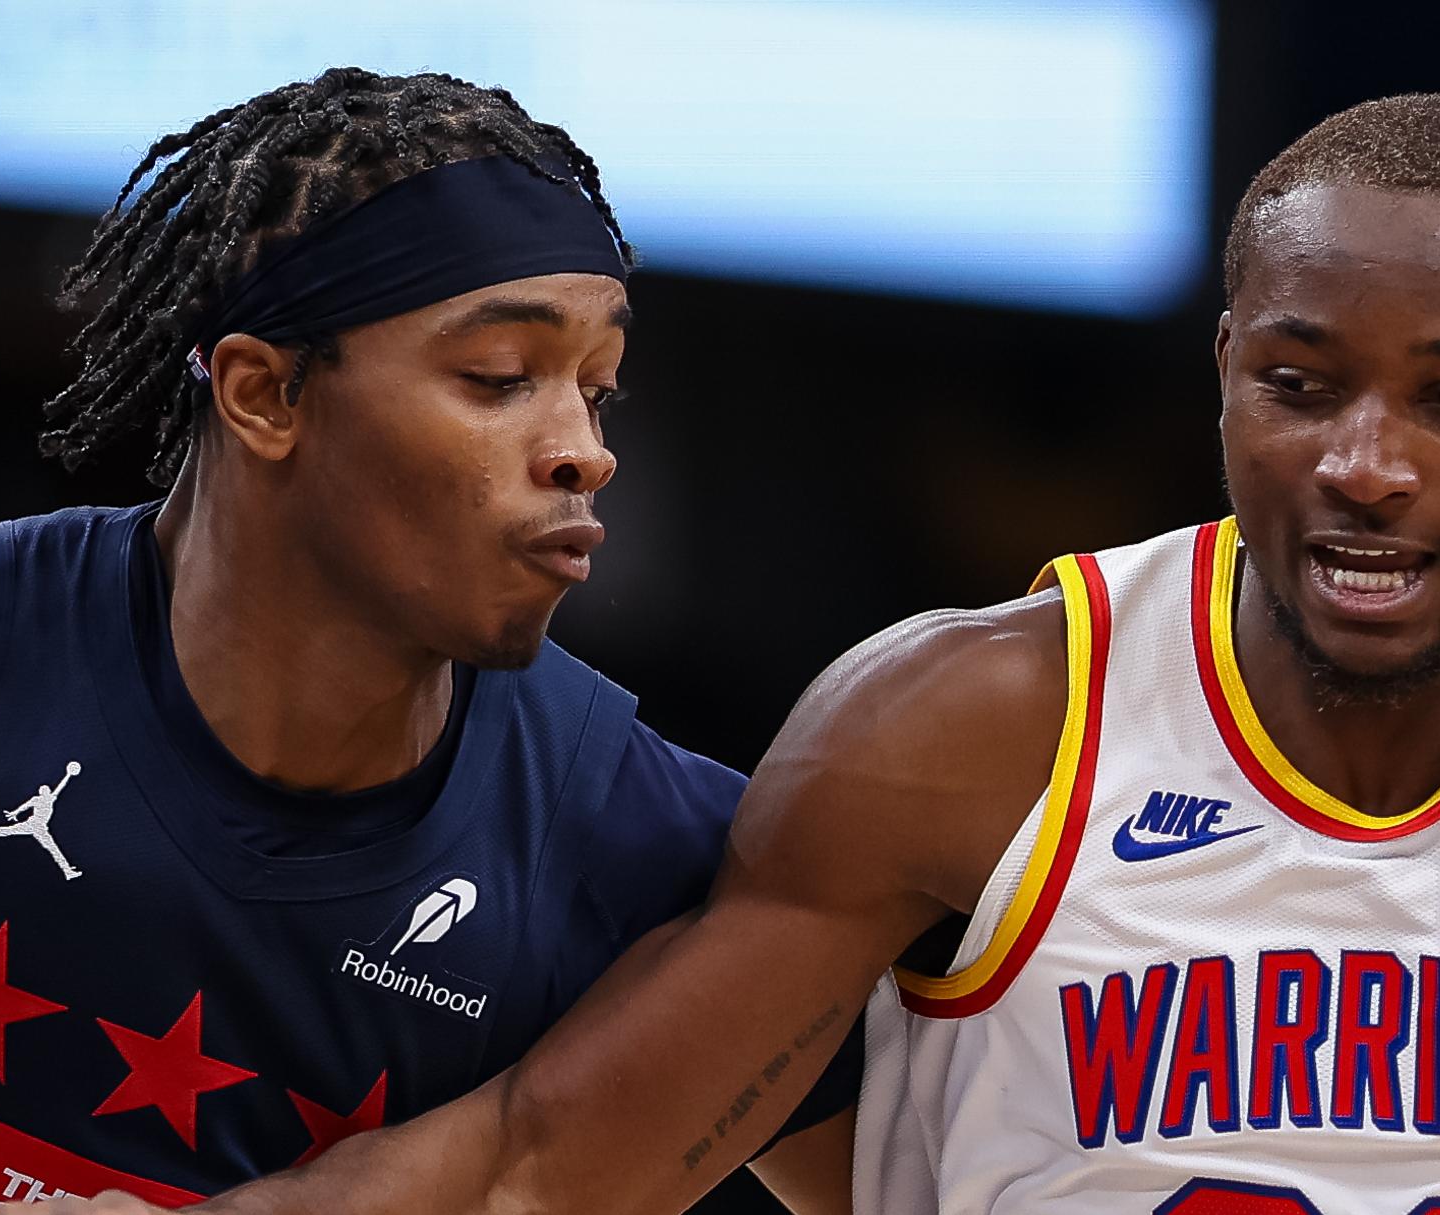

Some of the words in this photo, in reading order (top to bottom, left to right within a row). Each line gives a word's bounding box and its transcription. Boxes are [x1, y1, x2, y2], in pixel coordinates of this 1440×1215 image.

[1133, 790, 1232, 840] NIKE
[341, 949, 487, 1019] Robinhood
[2, 1167, 88, 1203] TH
